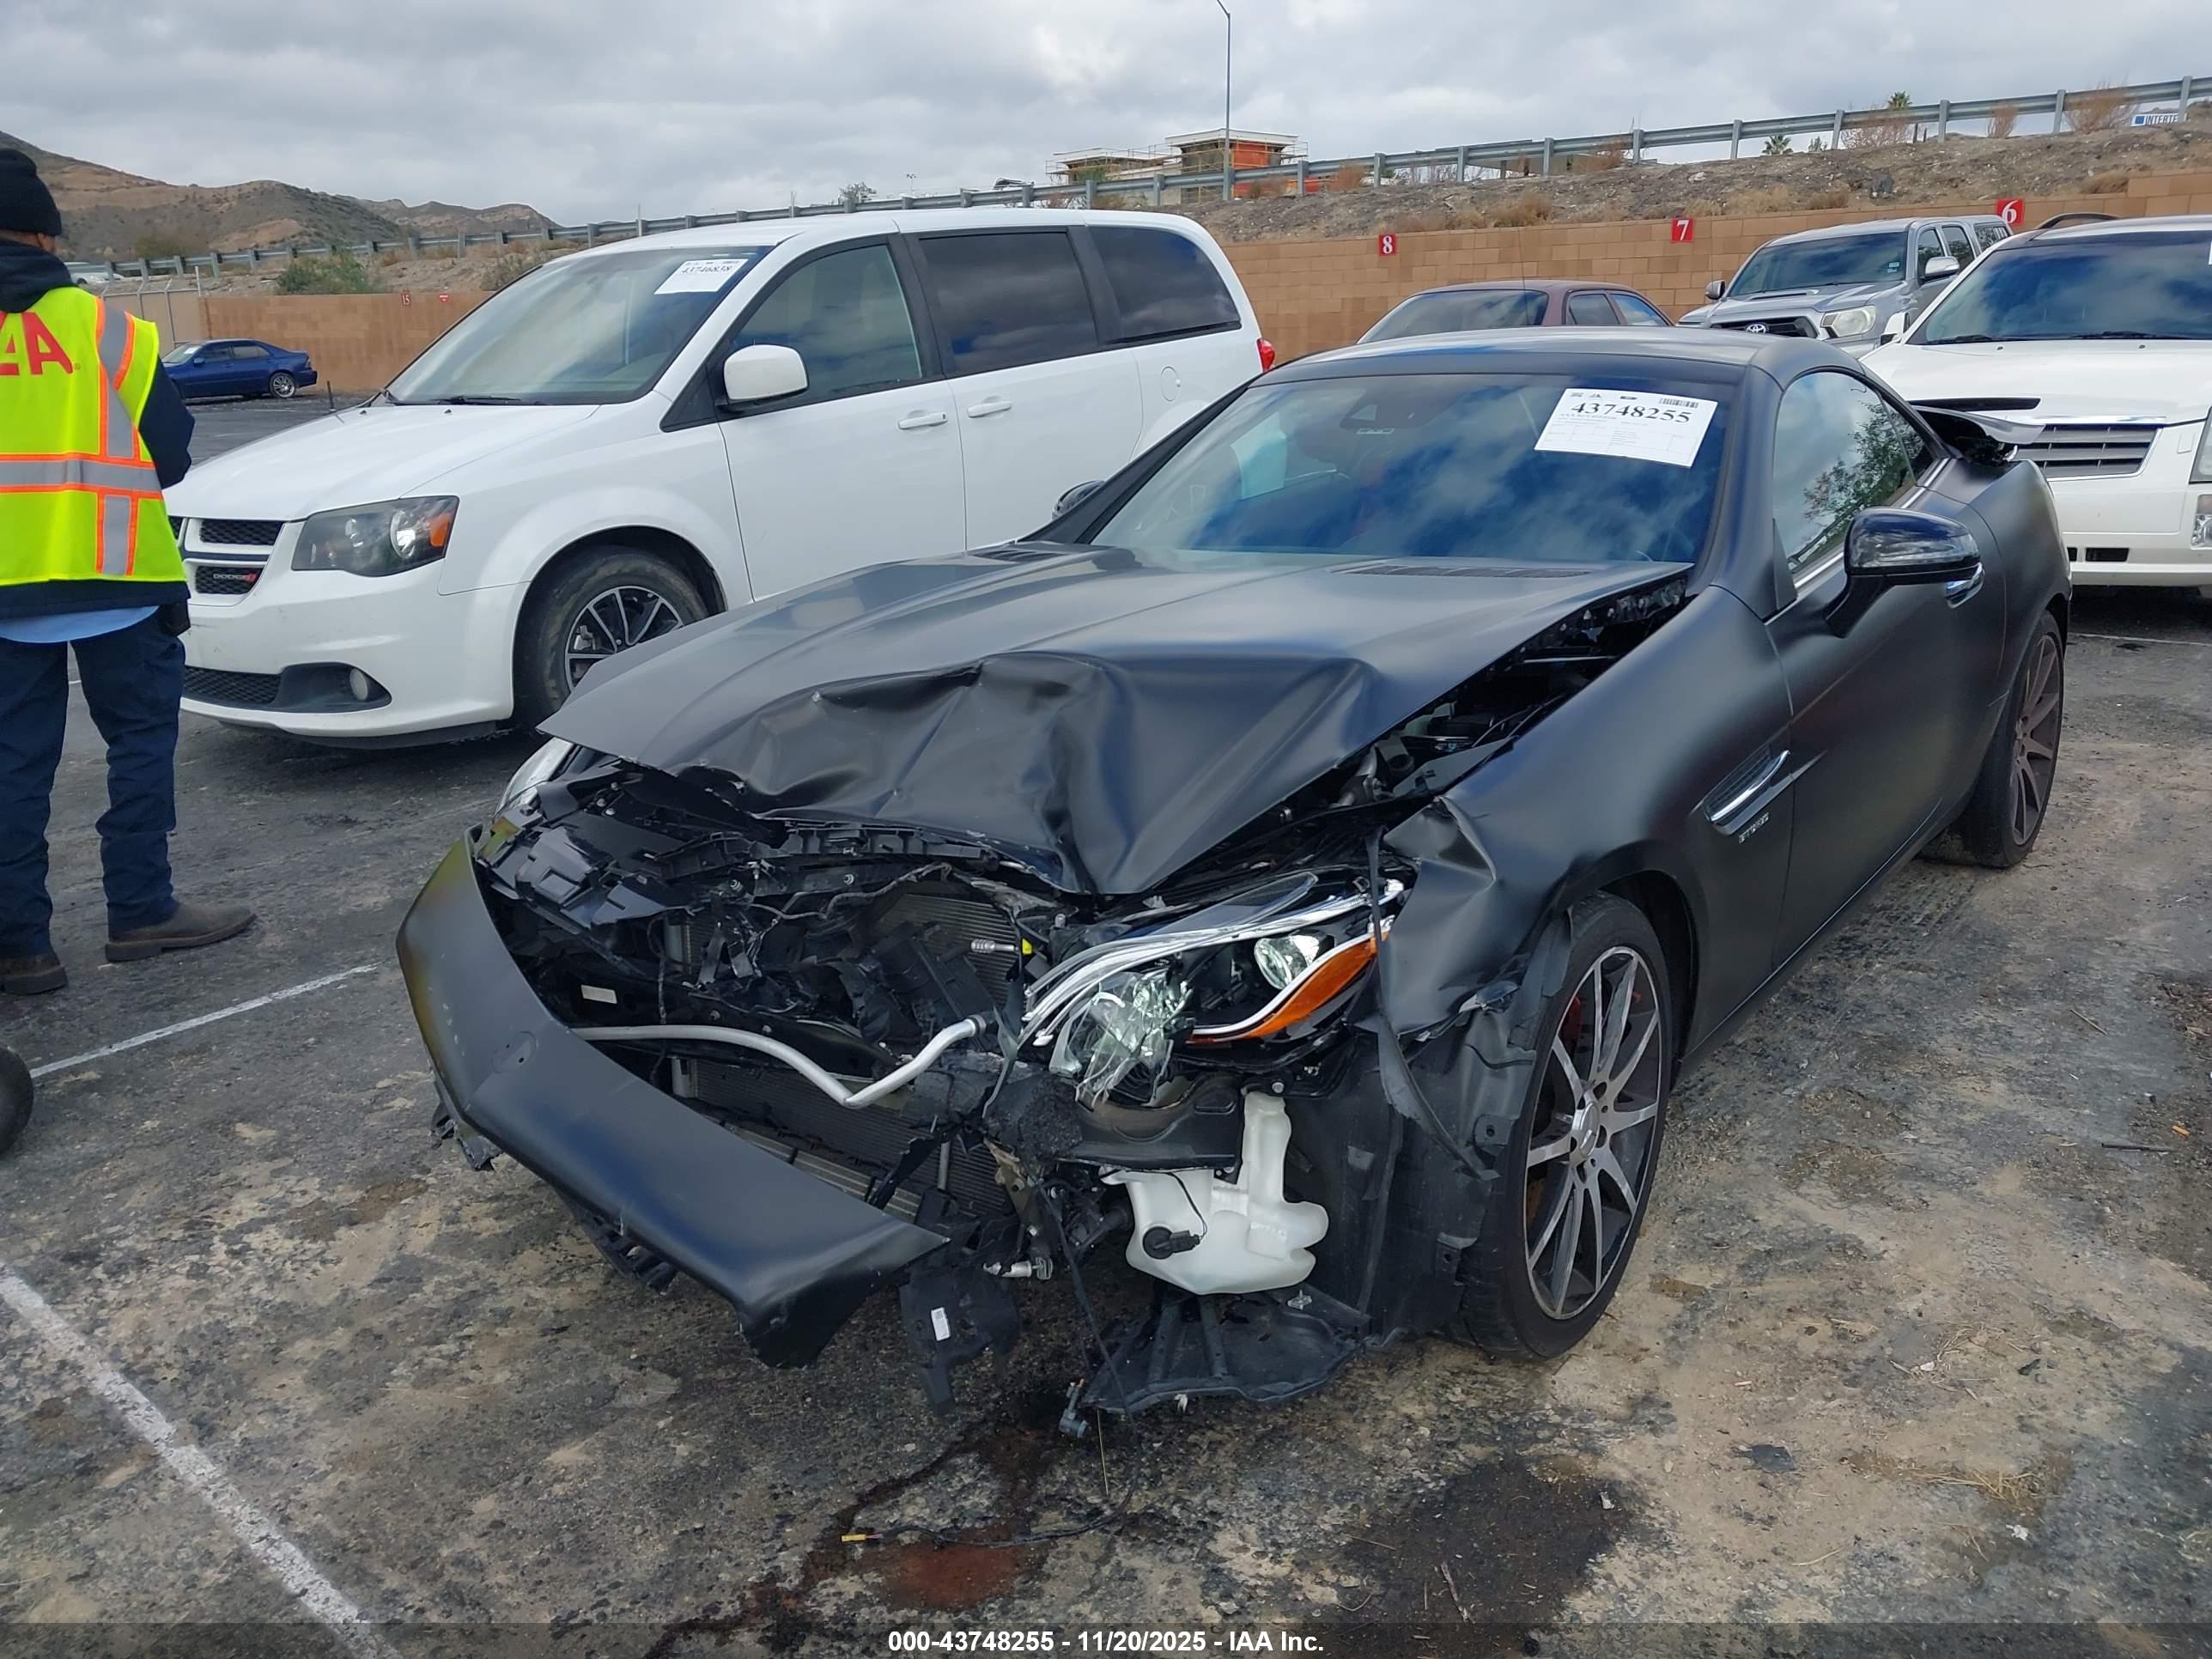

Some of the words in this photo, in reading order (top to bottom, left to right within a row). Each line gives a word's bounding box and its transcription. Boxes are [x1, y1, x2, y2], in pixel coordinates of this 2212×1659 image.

[2002, 199, 2019, 224] 6
[1676, 219, 1690, 241] 7
[1382, 235, 1393, 254] 8
[1571, 402, 1692, 423] 43748255
